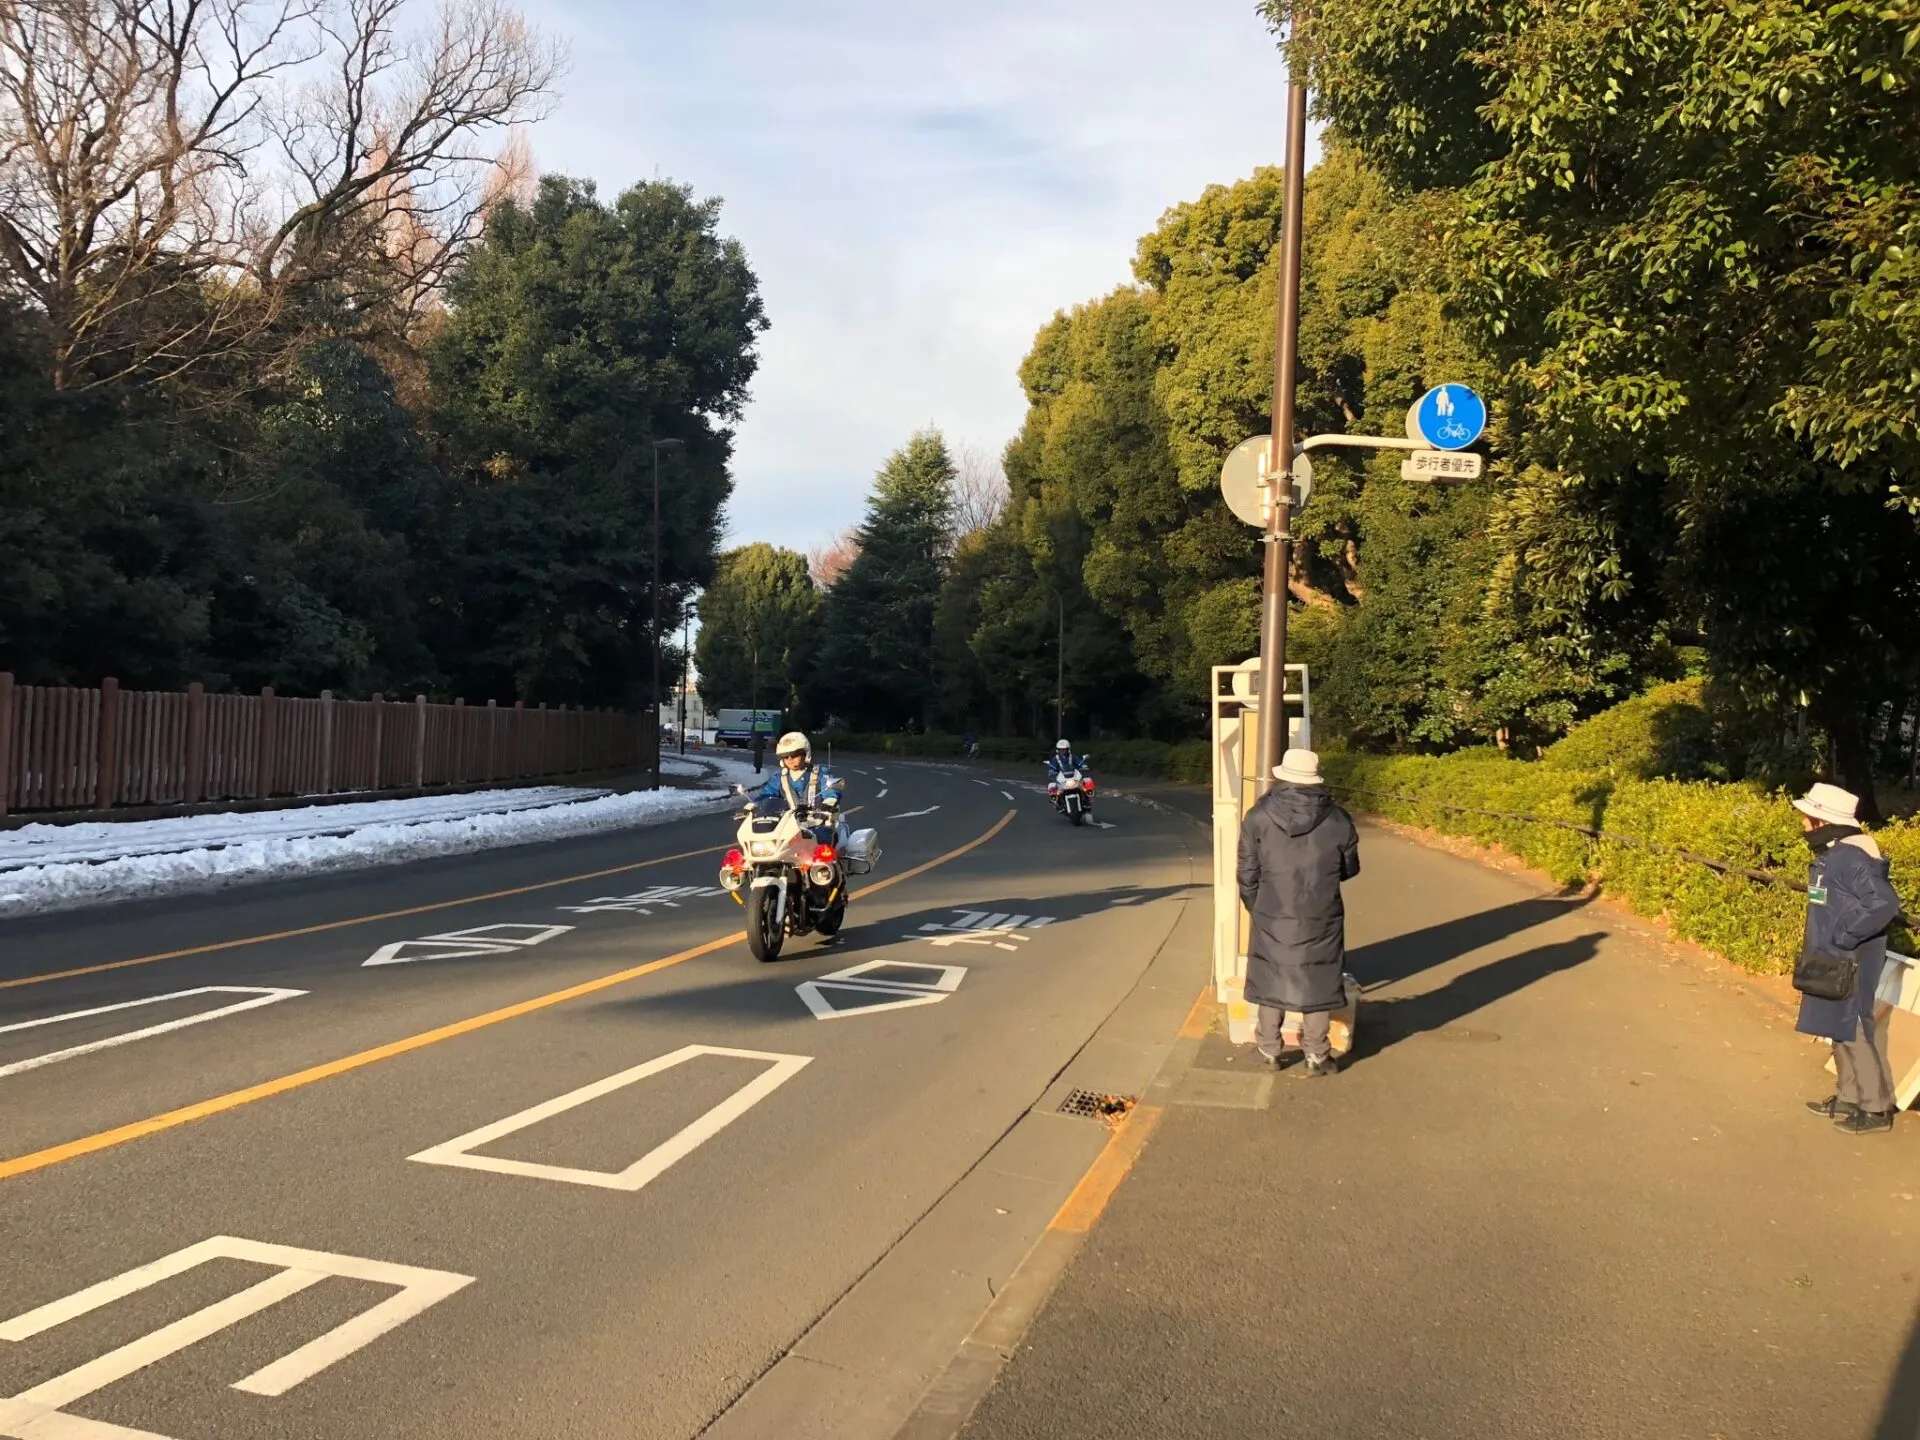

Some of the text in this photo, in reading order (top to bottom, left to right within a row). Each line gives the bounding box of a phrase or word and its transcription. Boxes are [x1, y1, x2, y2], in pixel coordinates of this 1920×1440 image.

[1416, 456, 1475, 473] 歩行者優先
